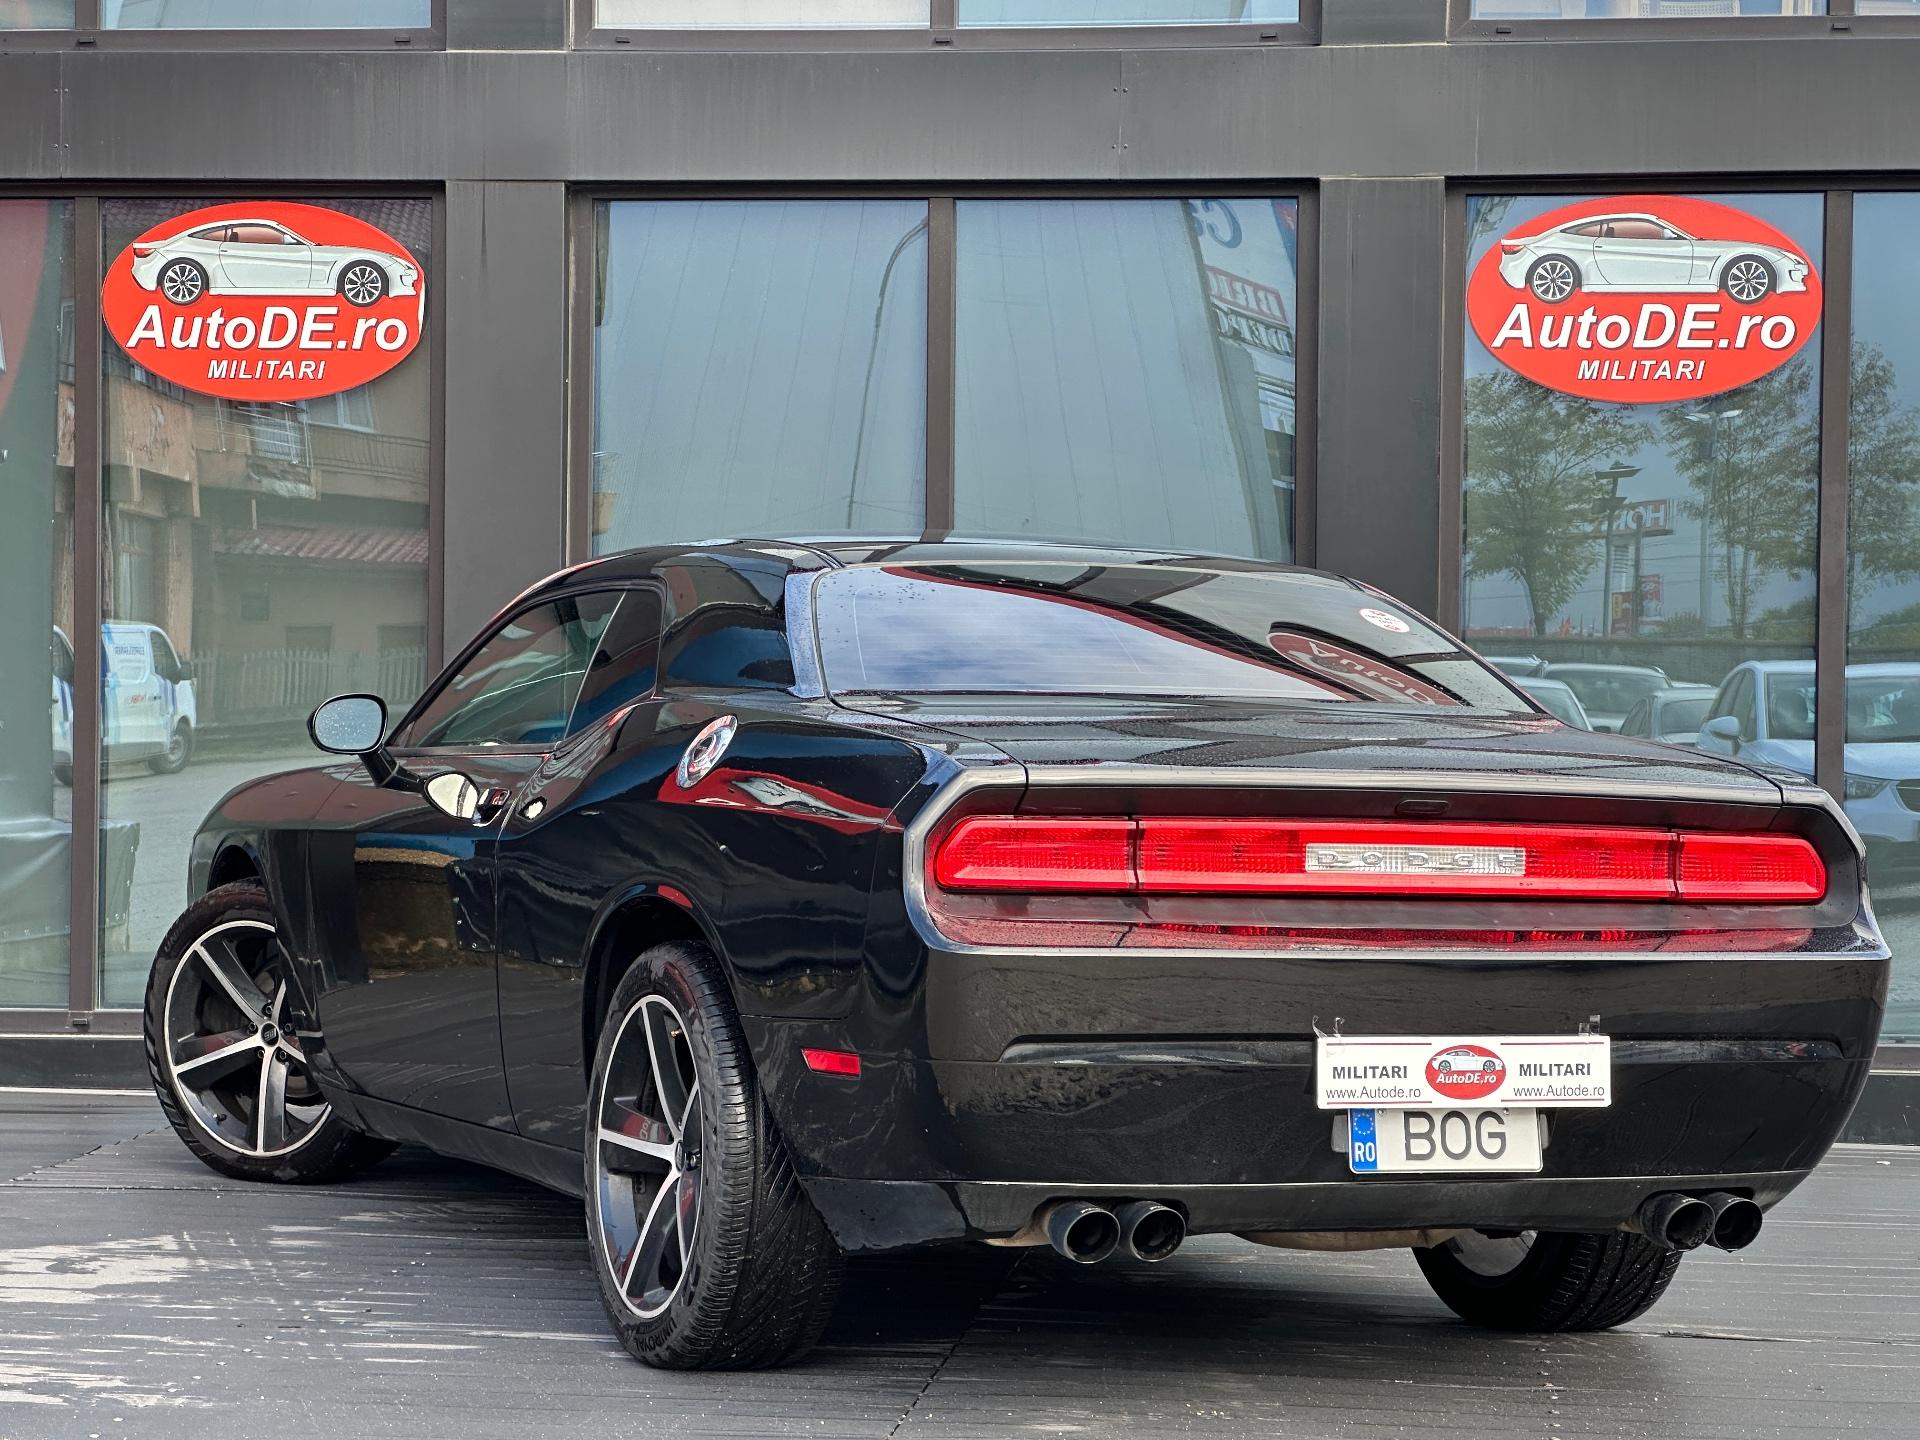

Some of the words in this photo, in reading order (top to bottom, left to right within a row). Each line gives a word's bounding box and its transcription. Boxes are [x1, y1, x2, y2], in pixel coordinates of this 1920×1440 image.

[126, 305, 408, 351] AutoDE.ro
[1491, 303, 1797, 350] AutoDE.ro
[207, 359, 326, 380] MILITARI
[1577, 359, 1706, 381] MILITARI
[1317, 850, 1518, 868] DODGE
[1332, 1065, 1408, 1080] MILITARI
[1436, 1072, 1497, 1085] AutoDE.ro
[1519, 1063, 1591, 1077] MILITARI
[1326, 1085, 1421, 1100] www.Autode.ro
[1513, 1085, 1605, 1098] www.Autode.ro
[1403, 1110, 1507, 1161] BOG
[1354, 1142, 1376, 1163] RO
[633, 1316, 678, 1353] UNIROYAL
